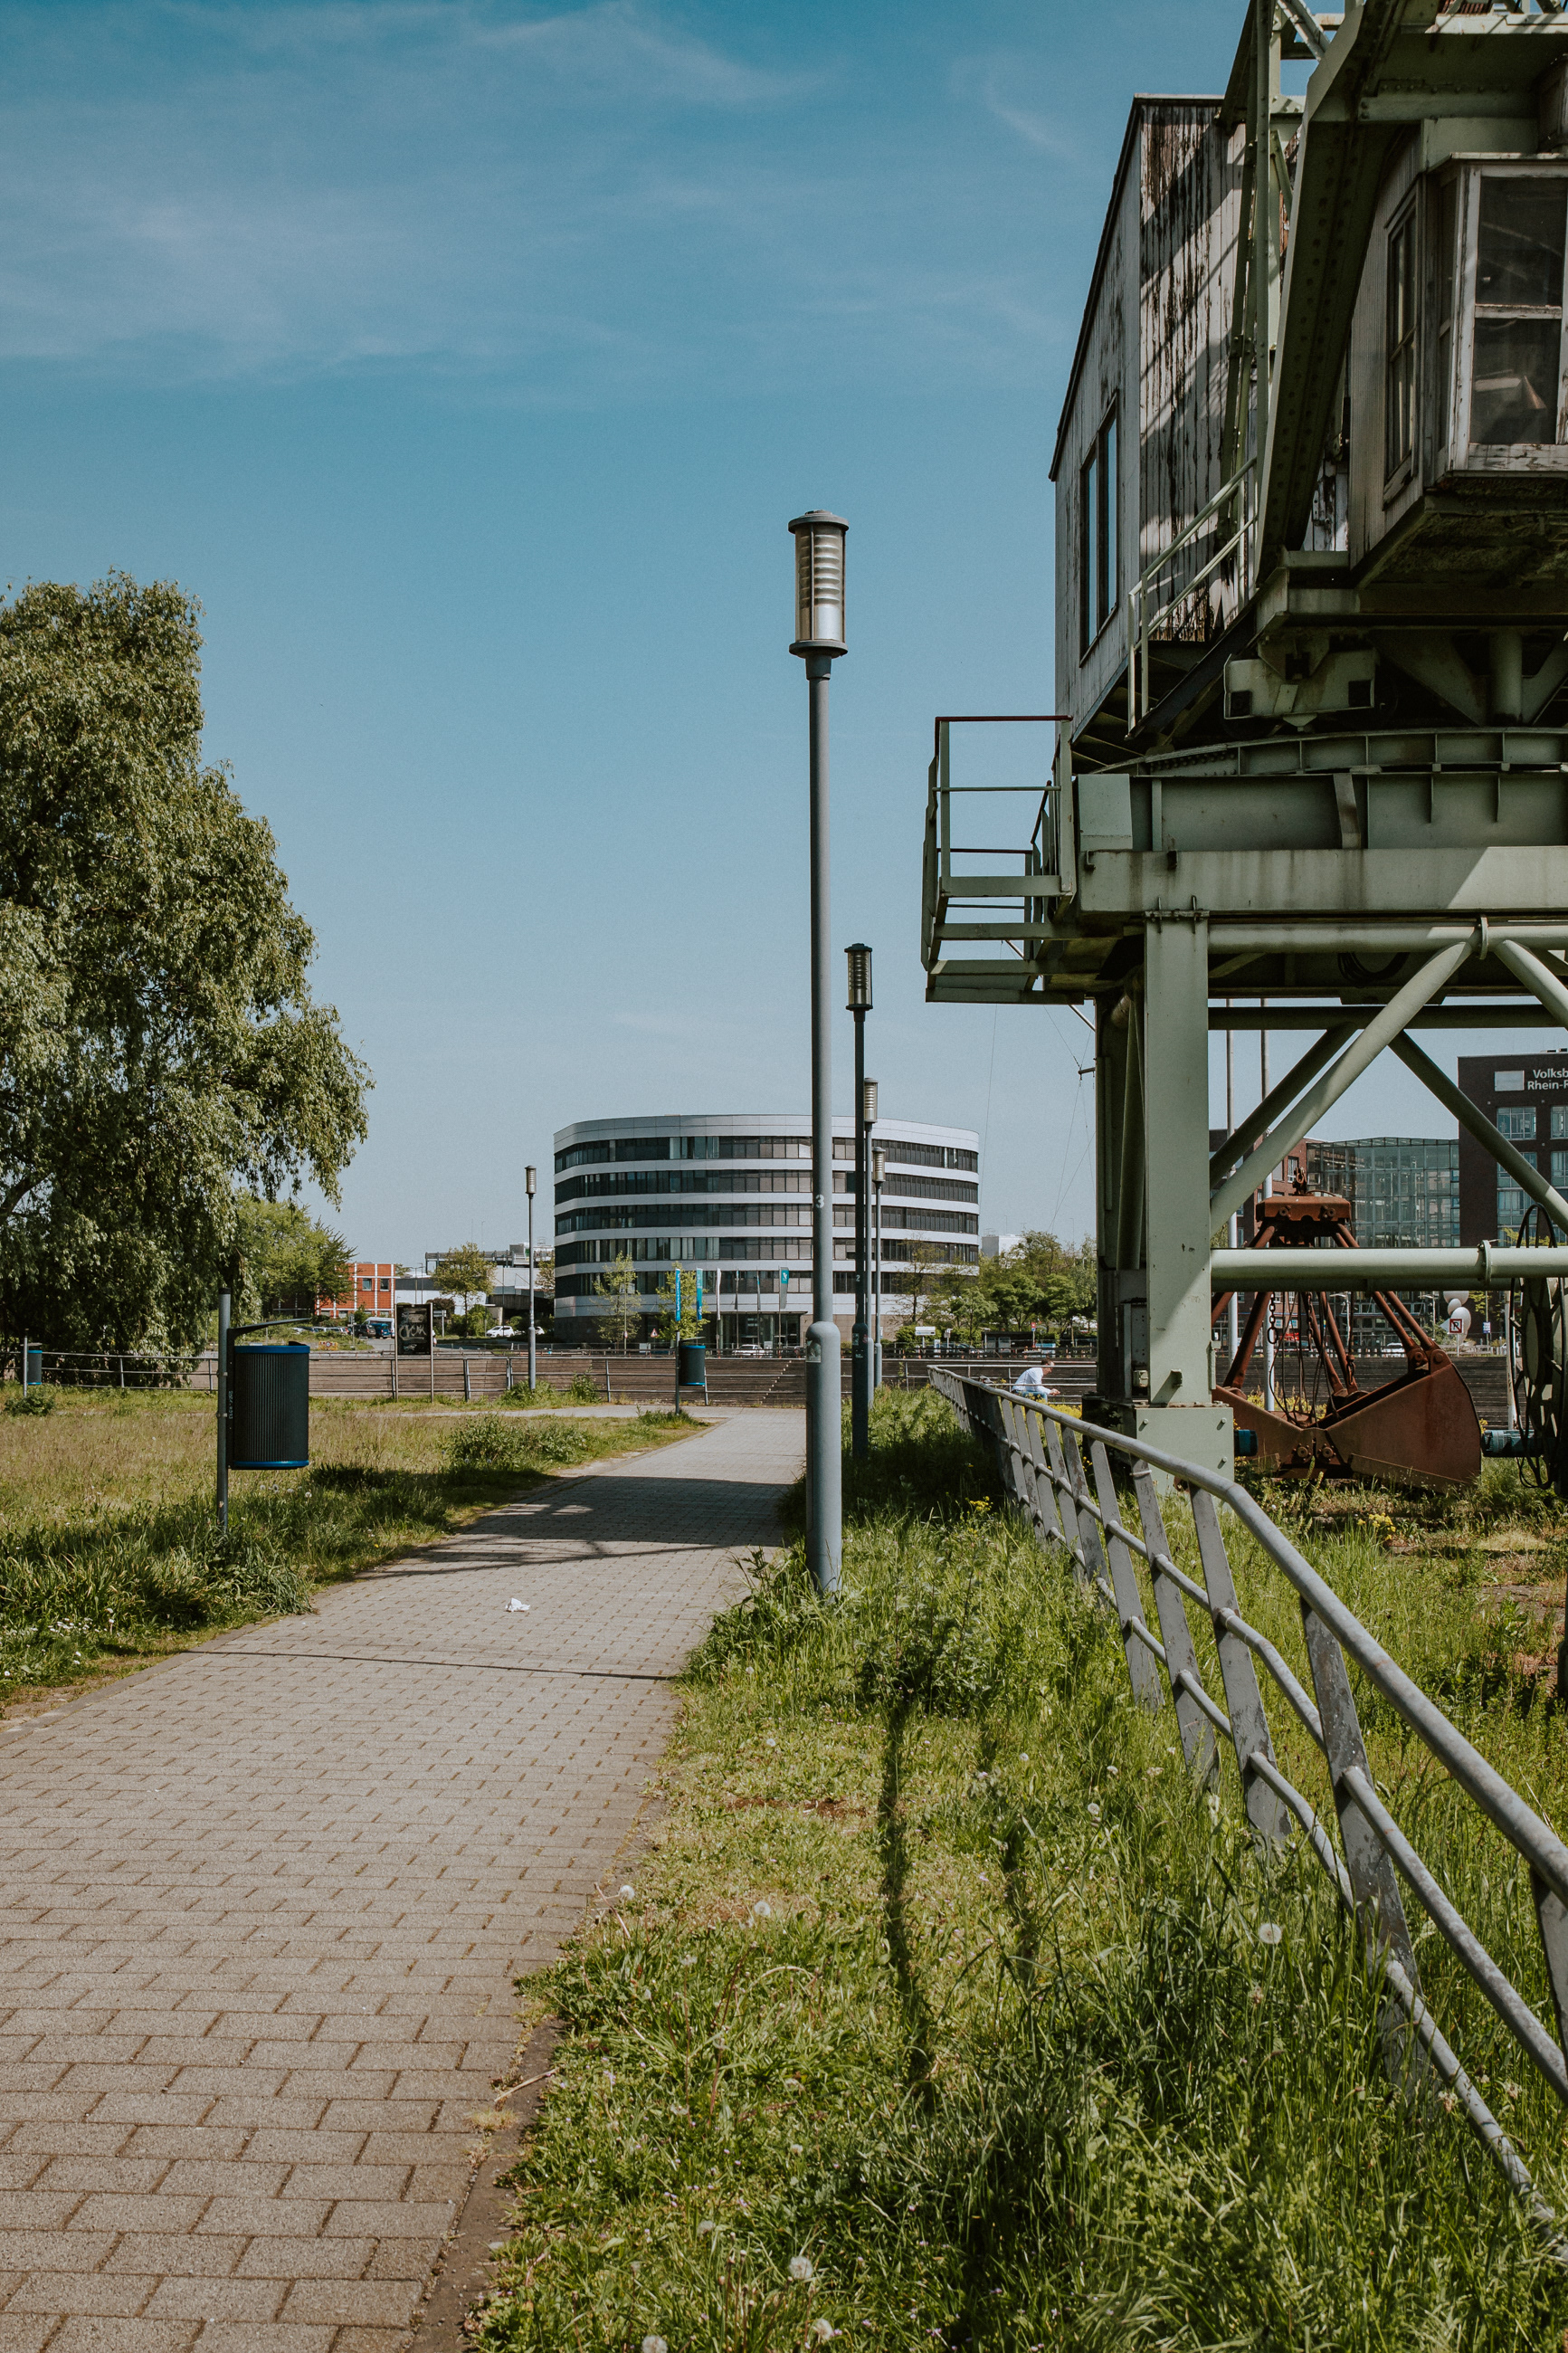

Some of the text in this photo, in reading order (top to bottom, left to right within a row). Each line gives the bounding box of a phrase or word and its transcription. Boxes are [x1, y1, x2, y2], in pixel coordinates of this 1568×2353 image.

[1533, 1068, 1568, 1079] Volksb
[815, 1194, 825, 1209] 3
[856, 1274, 860, 1282] 2
